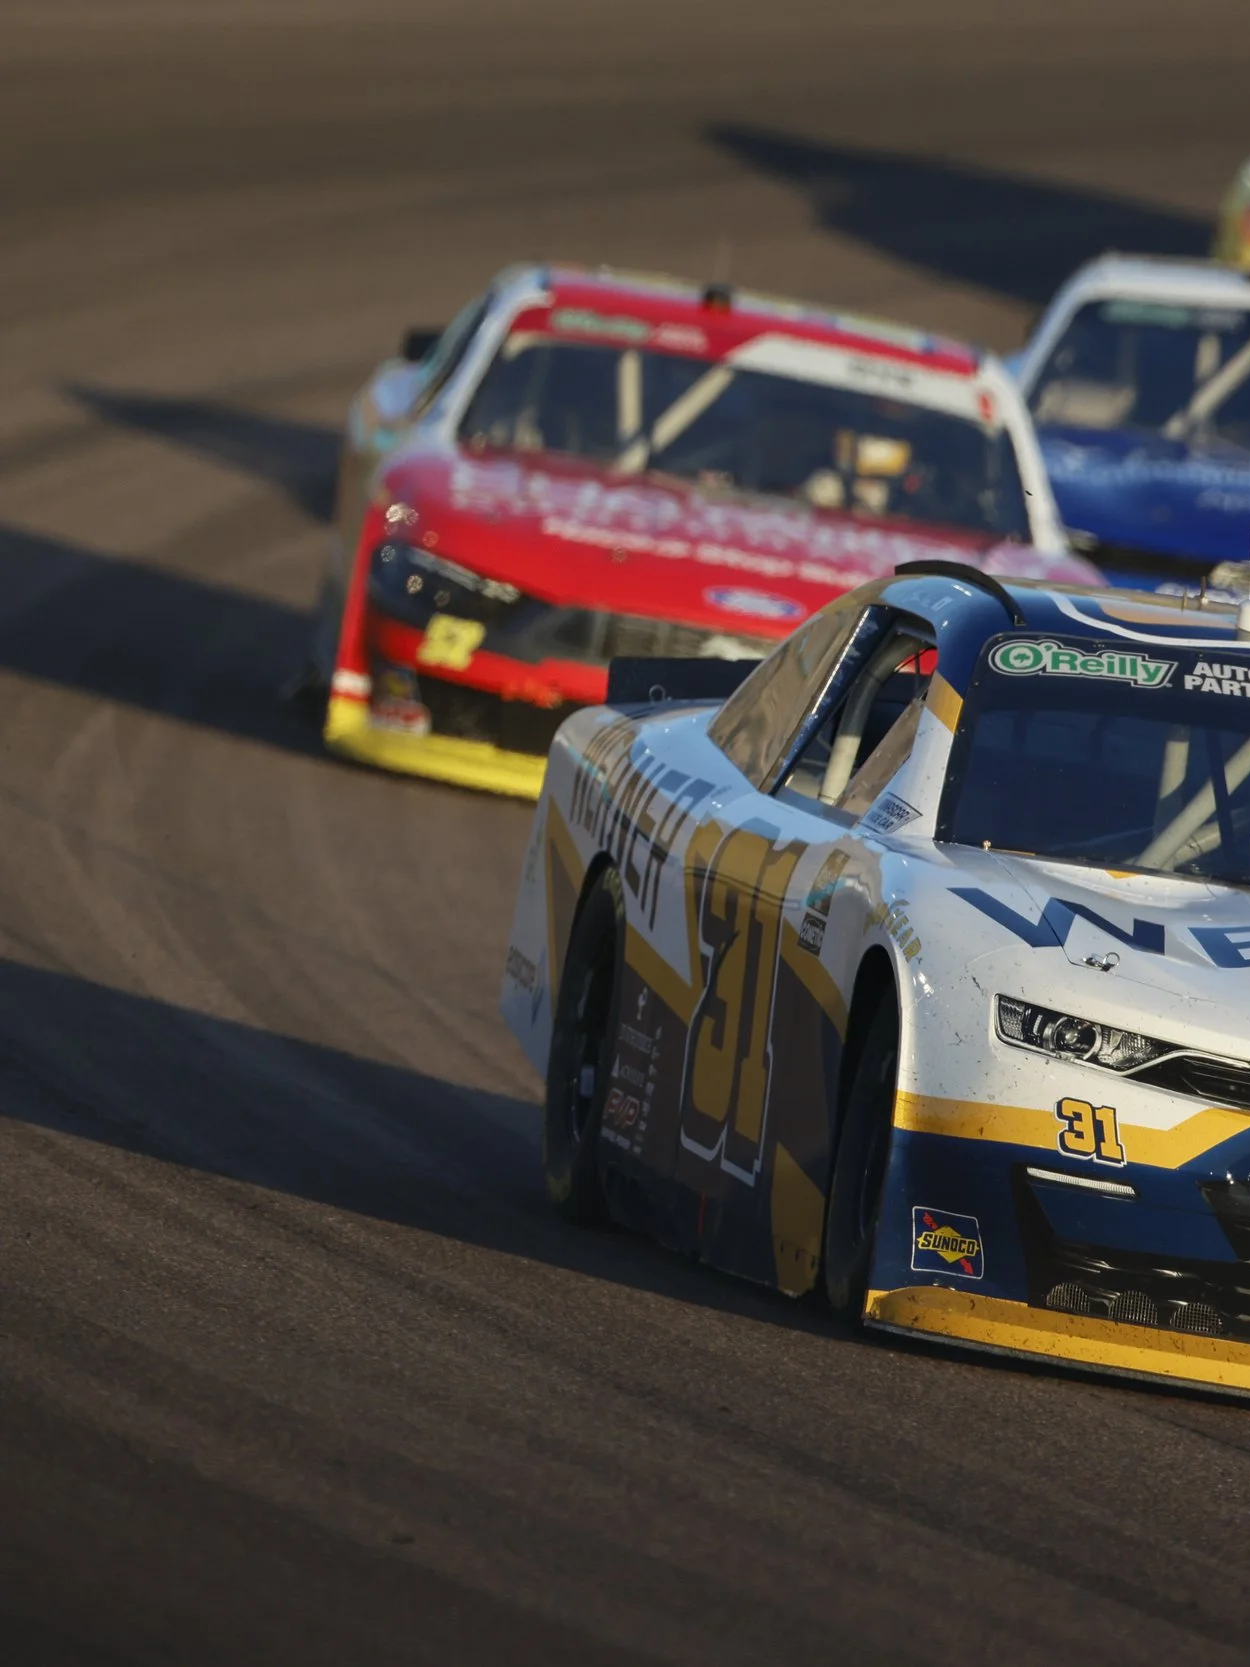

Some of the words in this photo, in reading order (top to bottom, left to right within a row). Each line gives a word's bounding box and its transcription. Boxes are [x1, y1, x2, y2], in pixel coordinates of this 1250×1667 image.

[997, 642, 1165, 685] O'Reilly
[682, 817, 806, 1186] 31
[1054, 1096, 1128, 1168] 31
[920, 1232, 978, 1256] SUNOCO
